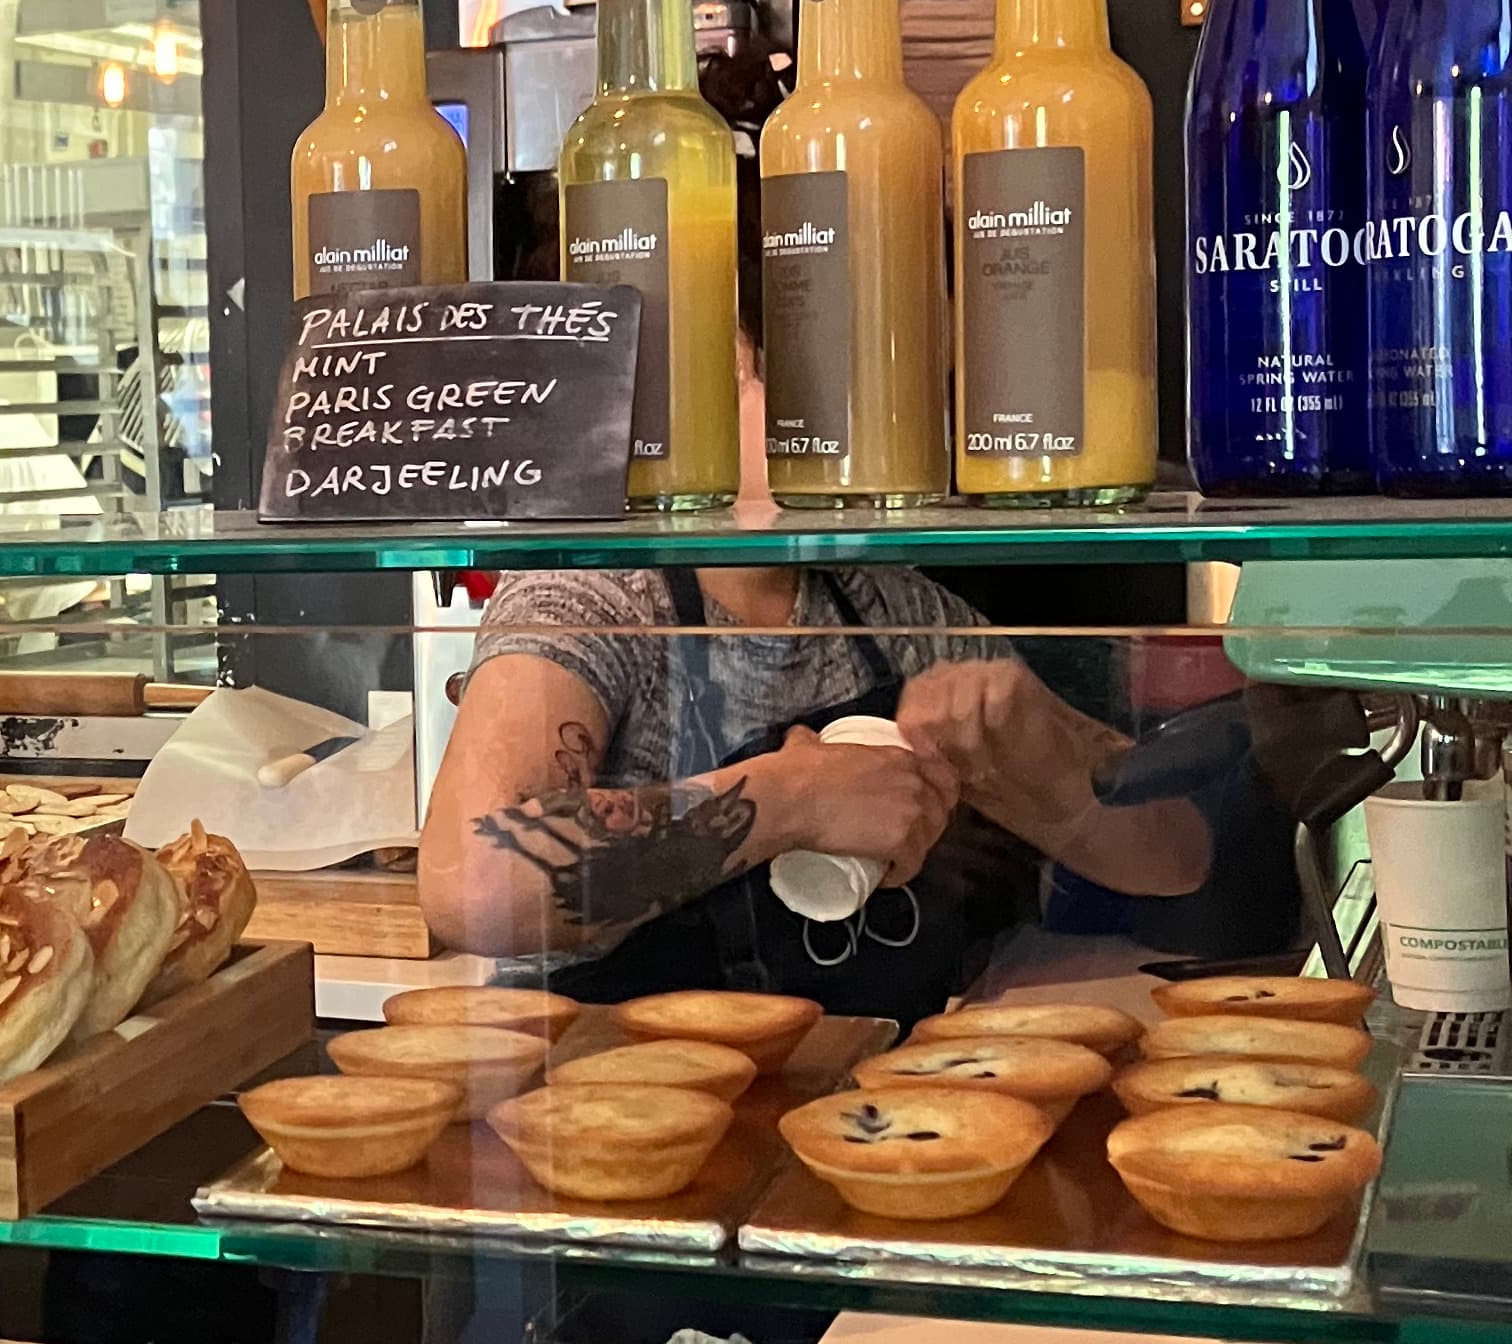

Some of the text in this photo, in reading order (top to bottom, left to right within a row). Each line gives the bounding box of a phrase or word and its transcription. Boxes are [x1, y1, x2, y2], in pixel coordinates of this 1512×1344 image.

[968, 200, 1072, 230] alain milliat
[602, 228, 657, 252] milliat
[784, 222, 835, 246] milliat
[314, 238, 410, 265] alain milliat
[1270, 278, 1323, 293] SILL
[298, 302, 430, 345] PALAIS
[440, 302, 493, 331] DES
[292, 351, 387, 383] MINT
[285, 378, 558, 423] PARIS GREEN
[992, 413, 1033, 423] FRANCE
[283, 417, 511, 453] BREAKFAST
[968, 433, 993, 451] 200
[285, 459, 543, 498] DARJEELING
